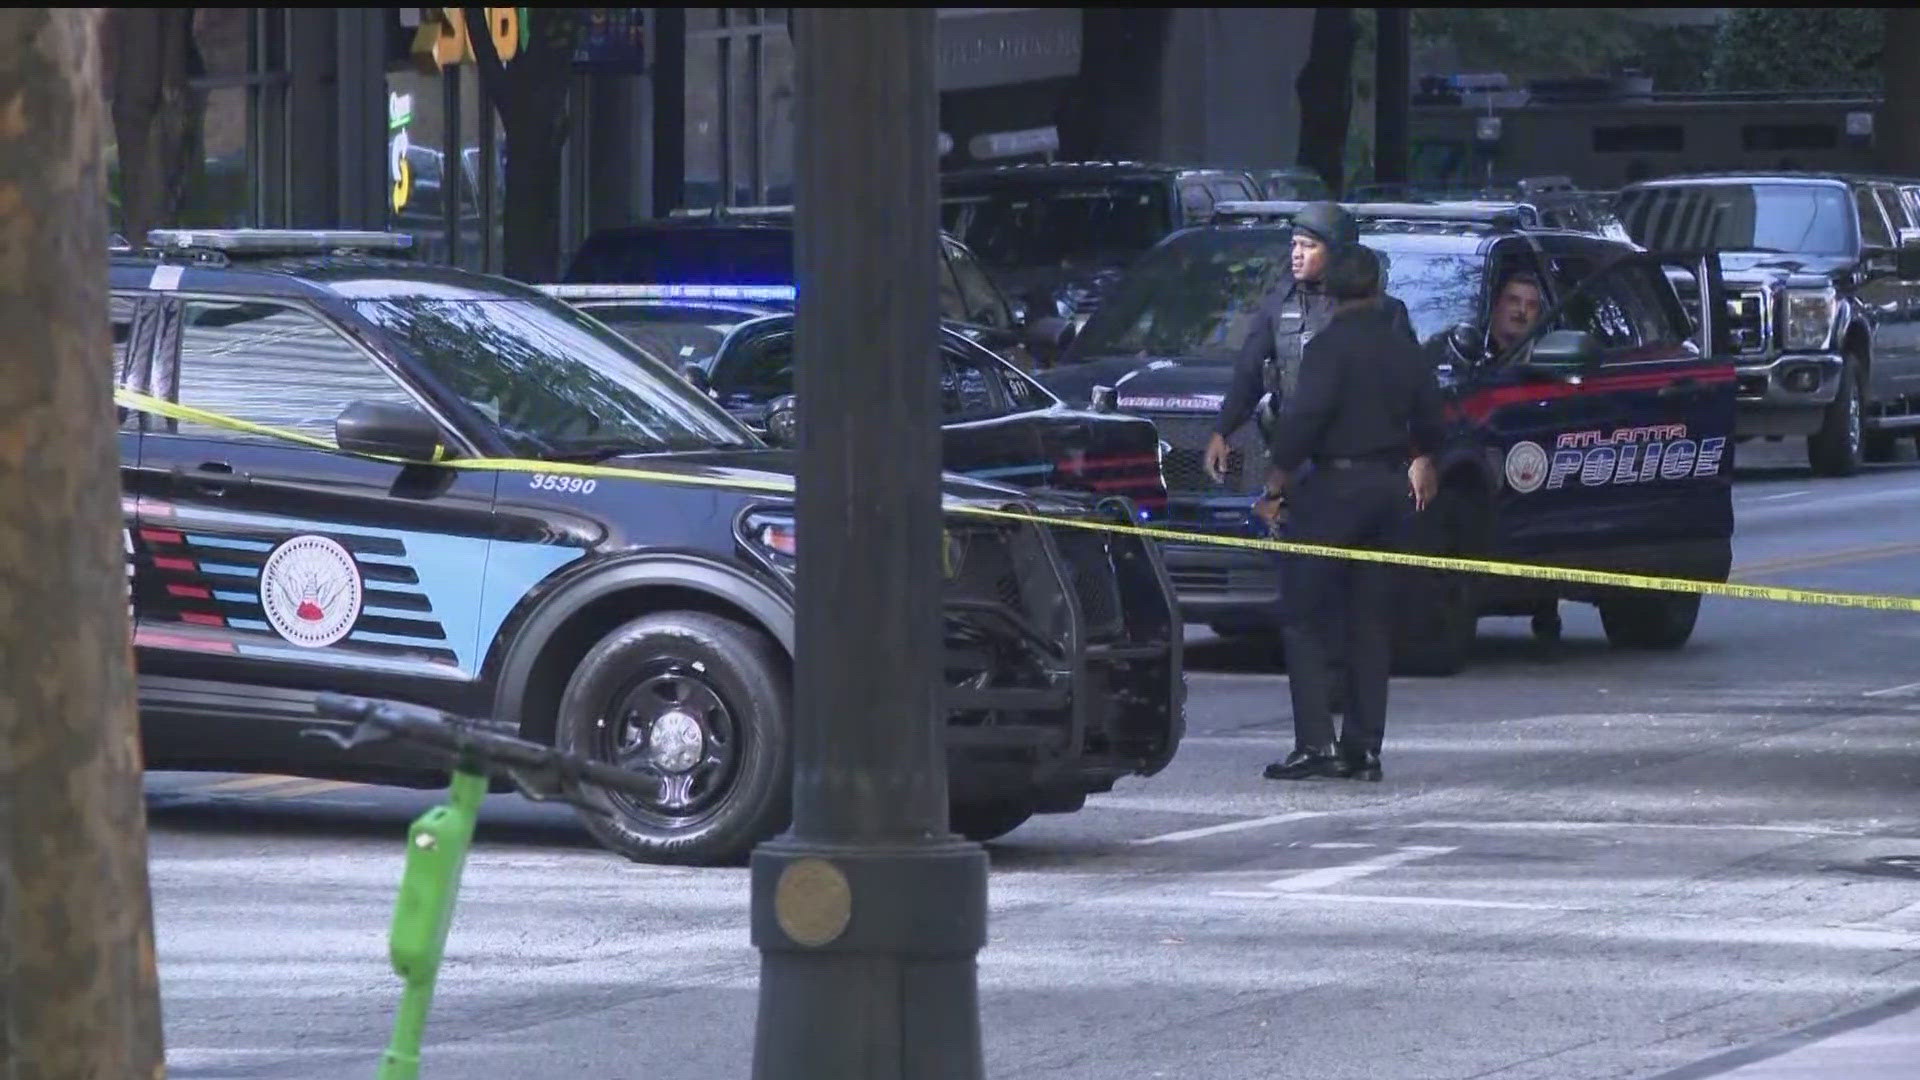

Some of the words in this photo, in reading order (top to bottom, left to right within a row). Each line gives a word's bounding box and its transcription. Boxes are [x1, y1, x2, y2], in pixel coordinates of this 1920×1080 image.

[1008, 379, 1029, 398] 911
[1556, 424, 1687, 449] ATLANTA
[1545, 436, 1726, 489] POLICE
[529, 473, 597, 494] 35390
